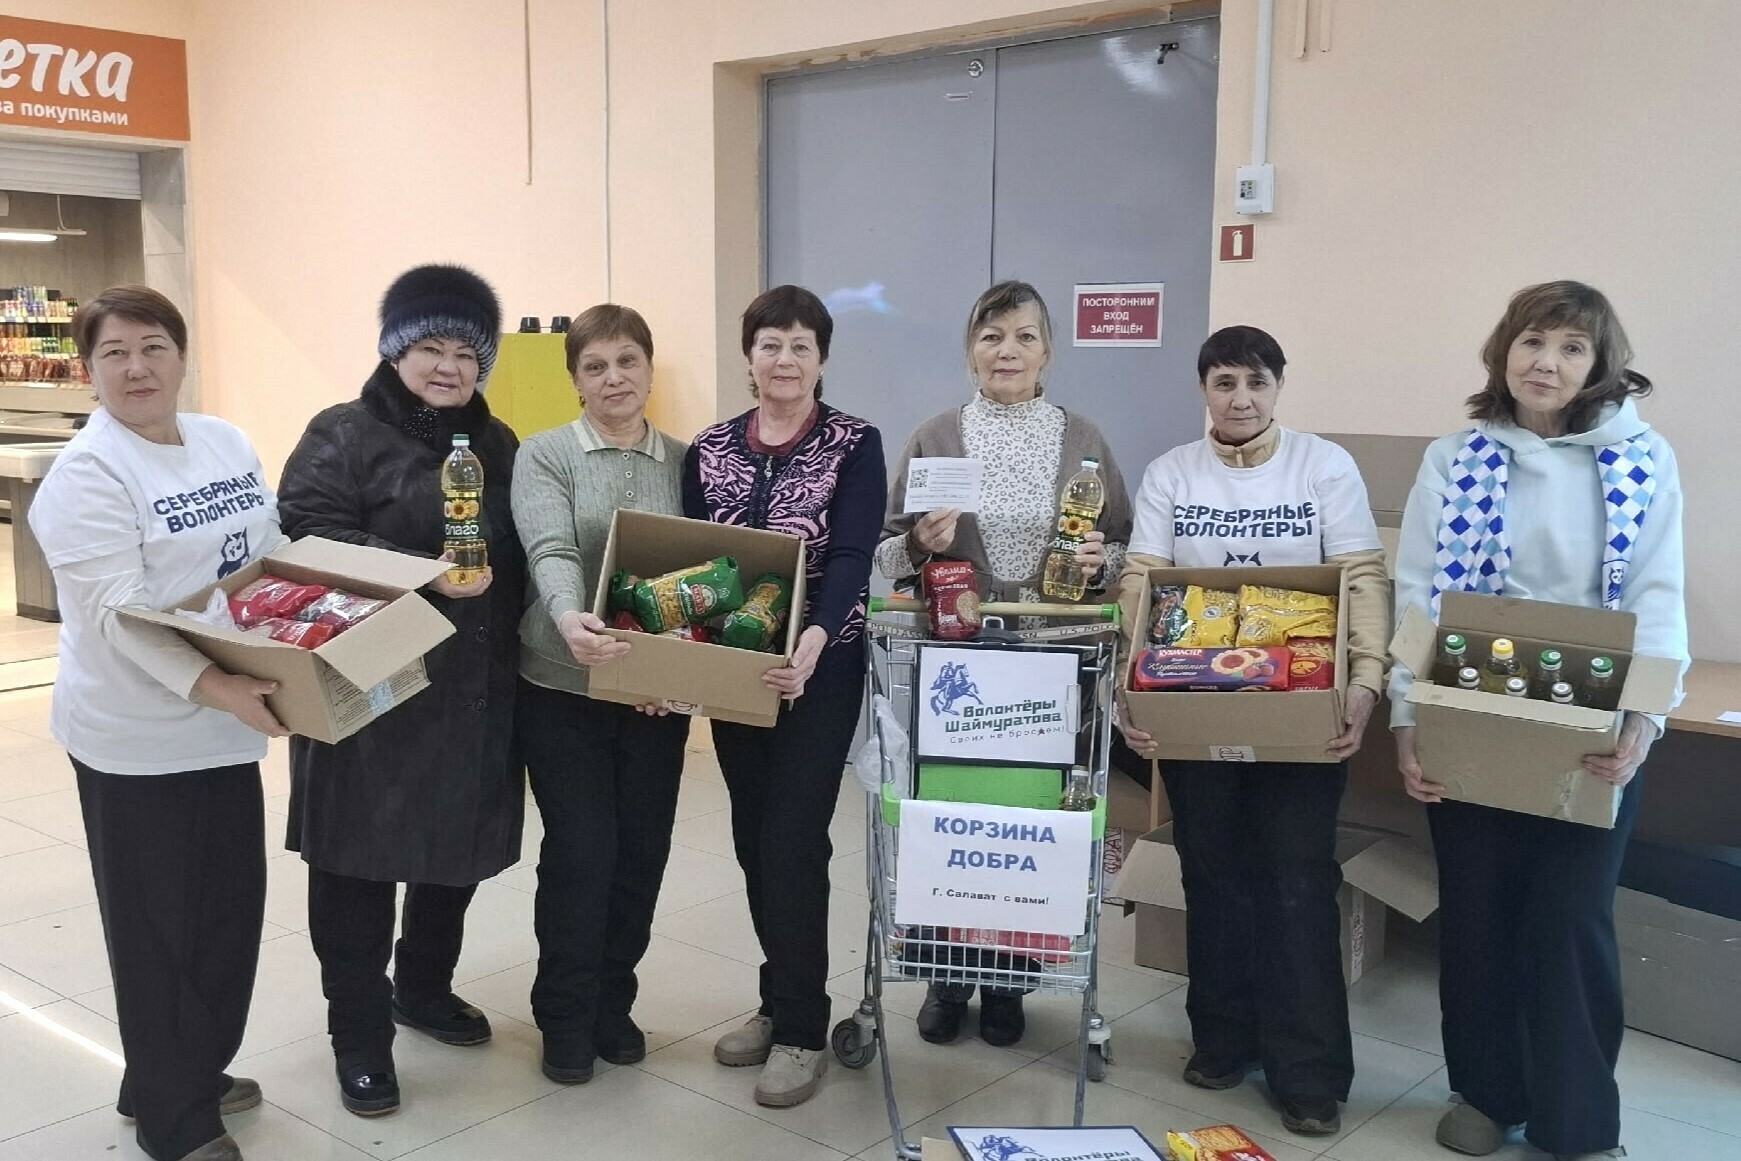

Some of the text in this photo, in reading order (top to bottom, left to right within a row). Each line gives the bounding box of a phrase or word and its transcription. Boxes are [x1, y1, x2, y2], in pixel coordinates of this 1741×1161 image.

[21, 102, 129, 126] покупками
[1082, 297, 1156, 307] ПОСТОРОННИМ
[1103, 311, 1130, 321] ВХОД
[1090, 323, 1144, 335] ЗАПРЕЩЁН
[1174, 501, 1316, 523] СЕРЕБРЯНЫЕ
[1174, 520, 1312, 538] ВОЛОНТЕРЫ
[963, 699, 1056, 718] Волонтёры
[945, 712, 1062, 732] Шаймуратова
[950, 735, 985, 744] Своих
[934, 816, 1057, 844] КОРЗИНА
[947, 848, 1037, 872] ДОБРА
[932, 887, 942, 897] Г.
[946, 888, 997, 901] Салават
[1014, 896, 1049, 905] вами!
